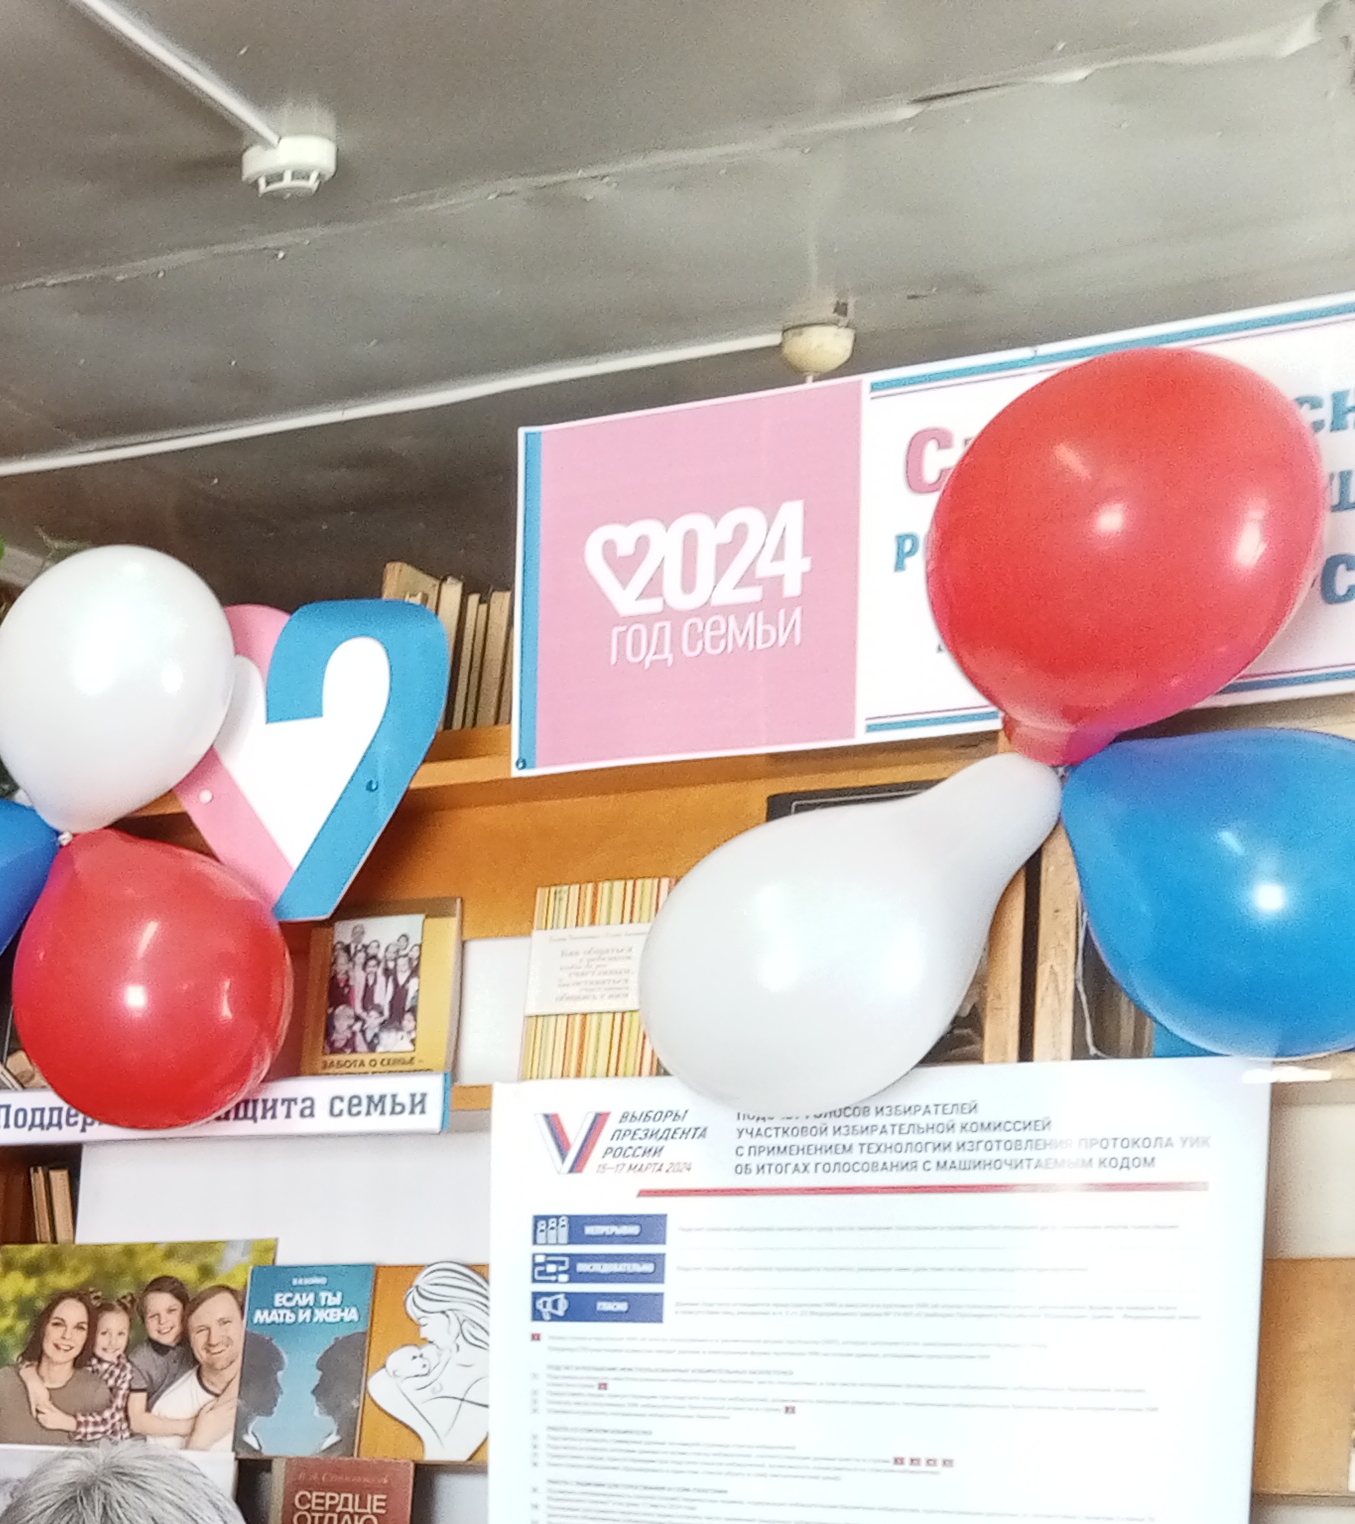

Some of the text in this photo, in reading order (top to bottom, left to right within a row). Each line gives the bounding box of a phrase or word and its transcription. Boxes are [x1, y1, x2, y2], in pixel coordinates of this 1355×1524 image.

[584, 500, 811, 616] 2024
[328, 1090, 428, 1118] семьи
[875, 1100, 979, 1116] ИЗБИРАТЕЛЕЙ
[618, 1109, 689, 1124] ВЫБОРЫ
[610, 1125, 709, 1141] ПРЕЗИДЕНТА
[737, 1118, 1052, 1139] УЧАСТКОВОЙ ИЗБИРАТЕЛЬНОЙ КОМИССИЕЙ
[601, 1145, 664, 1159] РОССИИ
[735, 1135, 1212, 1158] С ПРИМЕНЕНИЕМ ТЕХНОЛОГИИ ИЗГОТОВЛЕНИЯ ПРОТОКОЛА УИК
[626, 1161, 663, 1174] МАРТА
[734, 1156, 1156, 1175] ОБ ИТОГАХ ГОЛОСОВАНИЯ С МАШИНОЧИТАЕМЫМ КОДОМ
[274, 1291, 342, 1307] ЕСЛИ ТЫ
[253, 1306, 359, 1324] МАТЬ И ЖЕНА
[294, 1491, 388, 1514] СЕРДЦЕ
